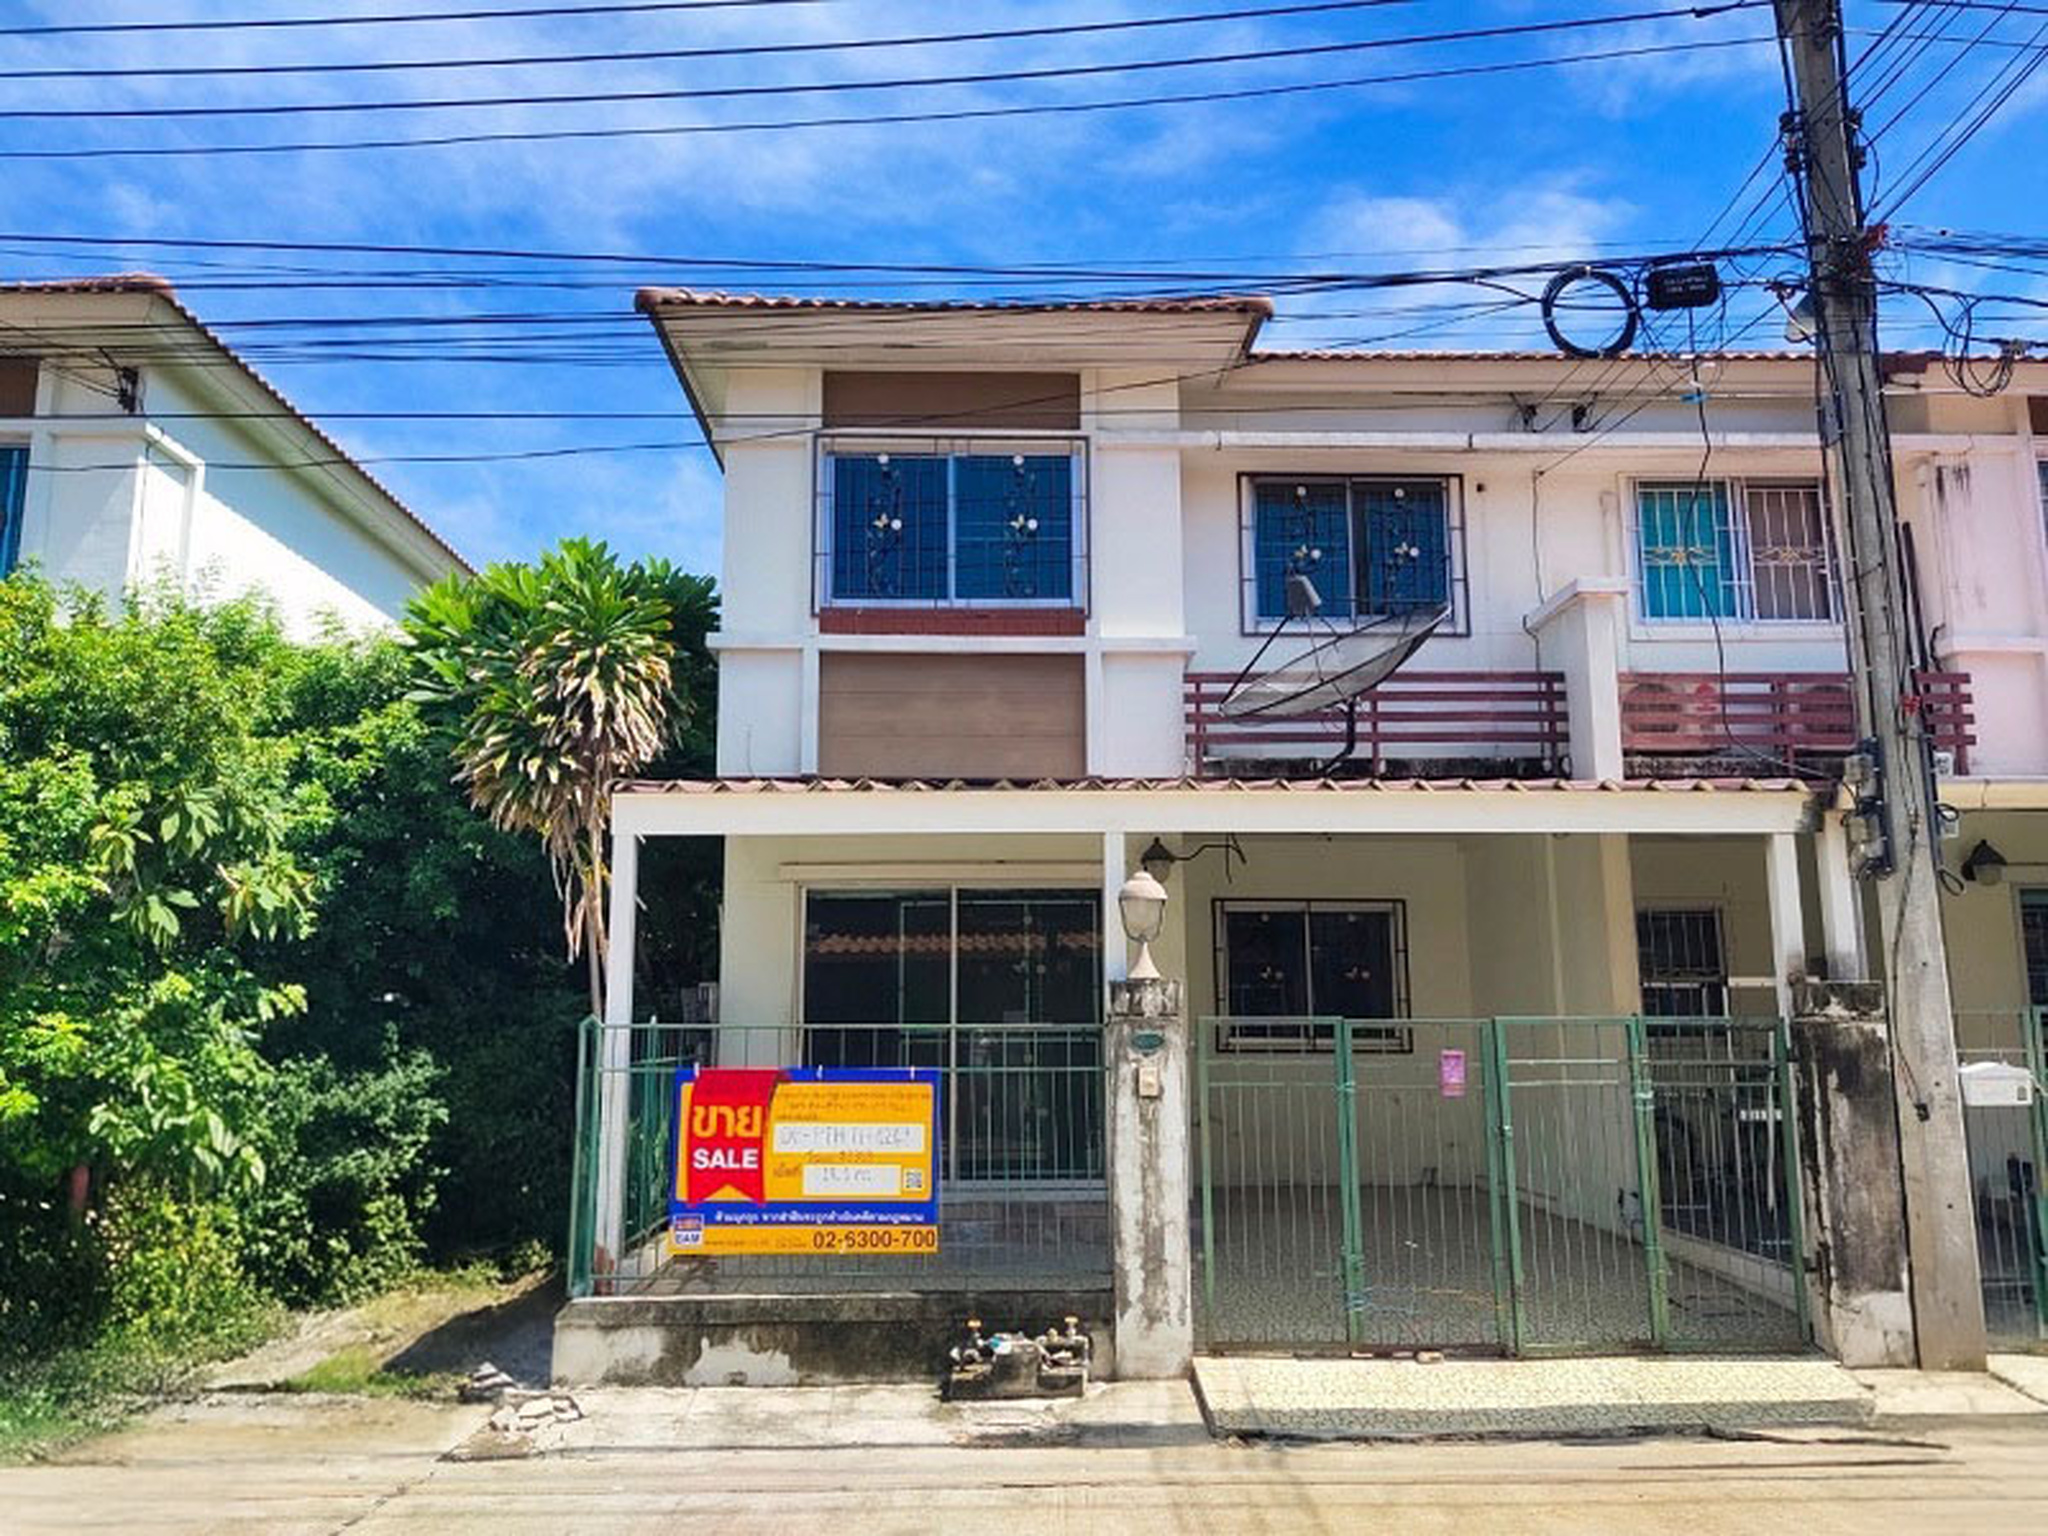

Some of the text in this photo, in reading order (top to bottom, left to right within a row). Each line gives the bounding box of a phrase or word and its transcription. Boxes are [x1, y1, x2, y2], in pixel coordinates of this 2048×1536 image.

[693, 1105, 762, 1137] ขาย
[693, 1147, 759, 1170] SALE
[813, 1229, 936, 1250] 02-6300-700
